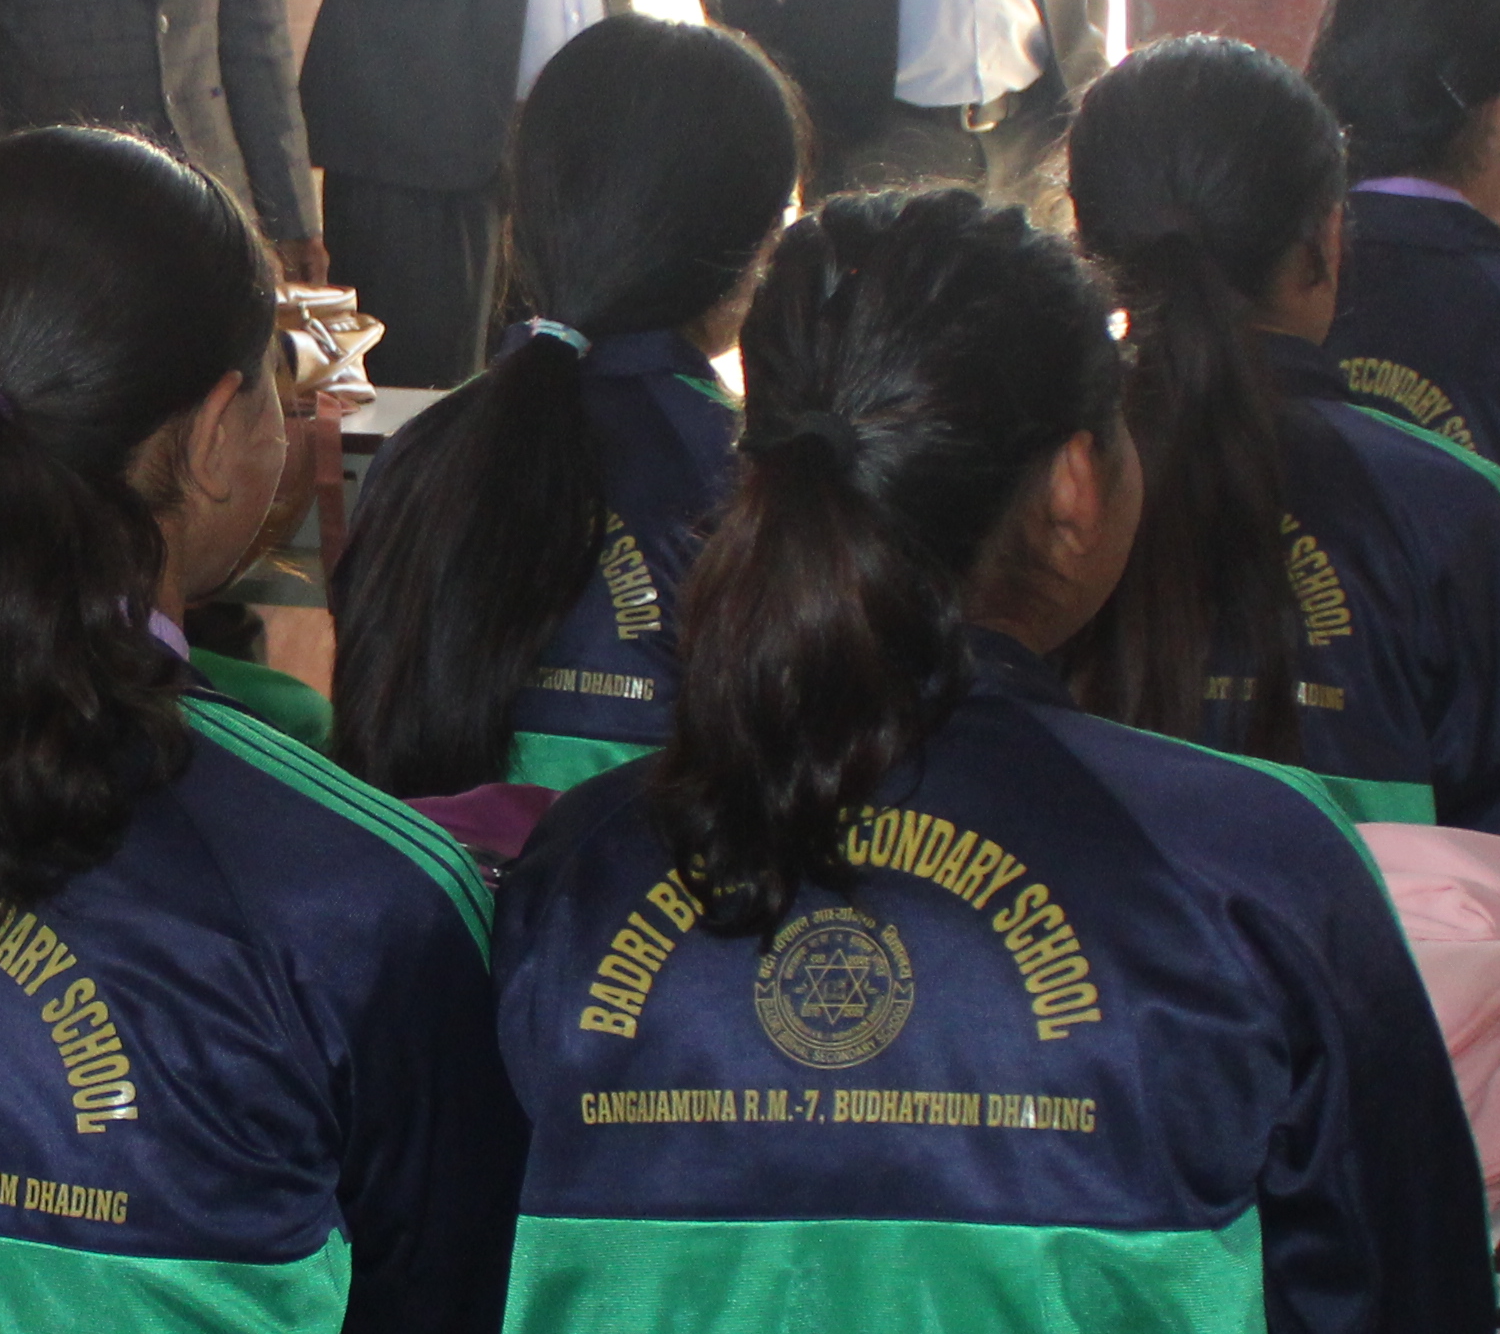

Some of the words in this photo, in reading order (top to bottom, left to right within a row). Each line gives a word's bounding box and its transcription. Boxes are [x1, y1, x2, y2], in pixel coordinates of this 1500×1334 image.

[1338, 357, 1453, 425] ECONDARY
[600, 535, 662, 641] SCHOOL
[1286, 535, 1353, 647] SCHOOL
[578, 670, 655, 702] DHADING
[579, 911, 676, 1039] BADRI
[992, 883, 1102, 1041] SCHOOL
[42, 977, 139, 1134] SCHOOL
[580, 1088, 737, 1126] GANGAJAMUNA
[833, 1088, 982, 1127] BUDHATHUM
[985, 1093, 1097, 1133] DHADING
[23, 1178, 130, 1225] DHADING
